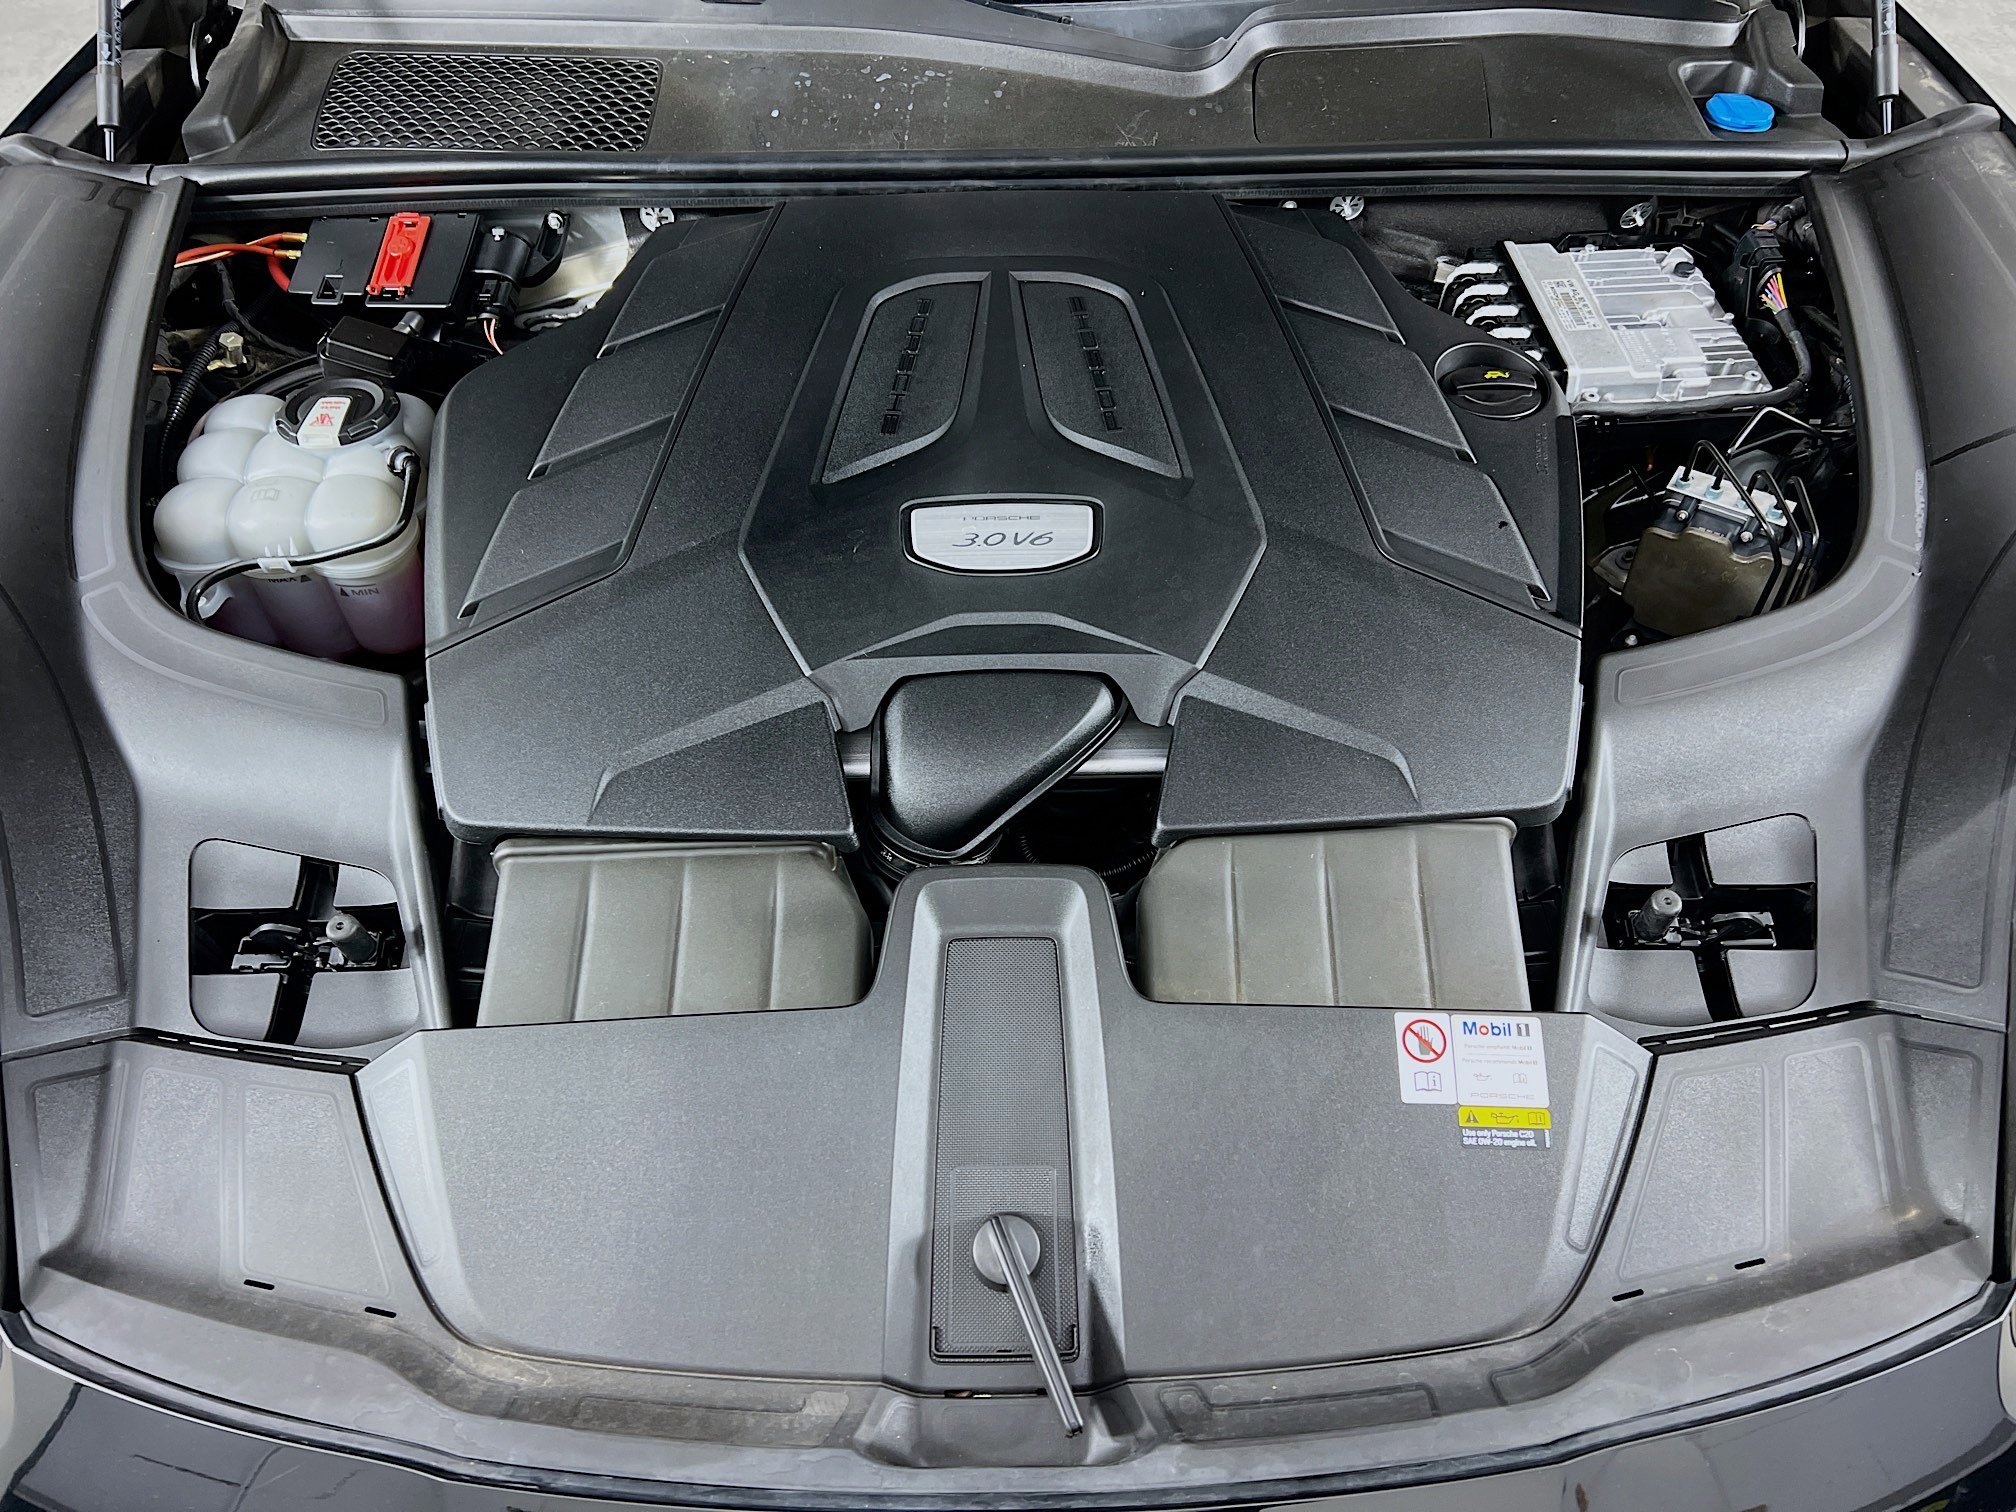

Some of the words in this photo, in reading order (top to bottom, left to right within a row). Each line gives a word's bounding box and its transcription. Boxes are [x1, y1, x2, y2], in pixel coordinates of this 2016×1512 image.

[351, 587, 380, 596] MIN
[1462, 1021, 1512, 1037] Mobil
[1470, 1092, 1536, 1100] PORSCHE
[1462, 1128, 1476, 1137] Use
[1476, 1130, 1491, 1139] only
[1491, 1129, 1518, 1138] Porsche
[1462, 1137, 1478, 1145] SAE
[1504, 1139, 1526, 1148] engine
